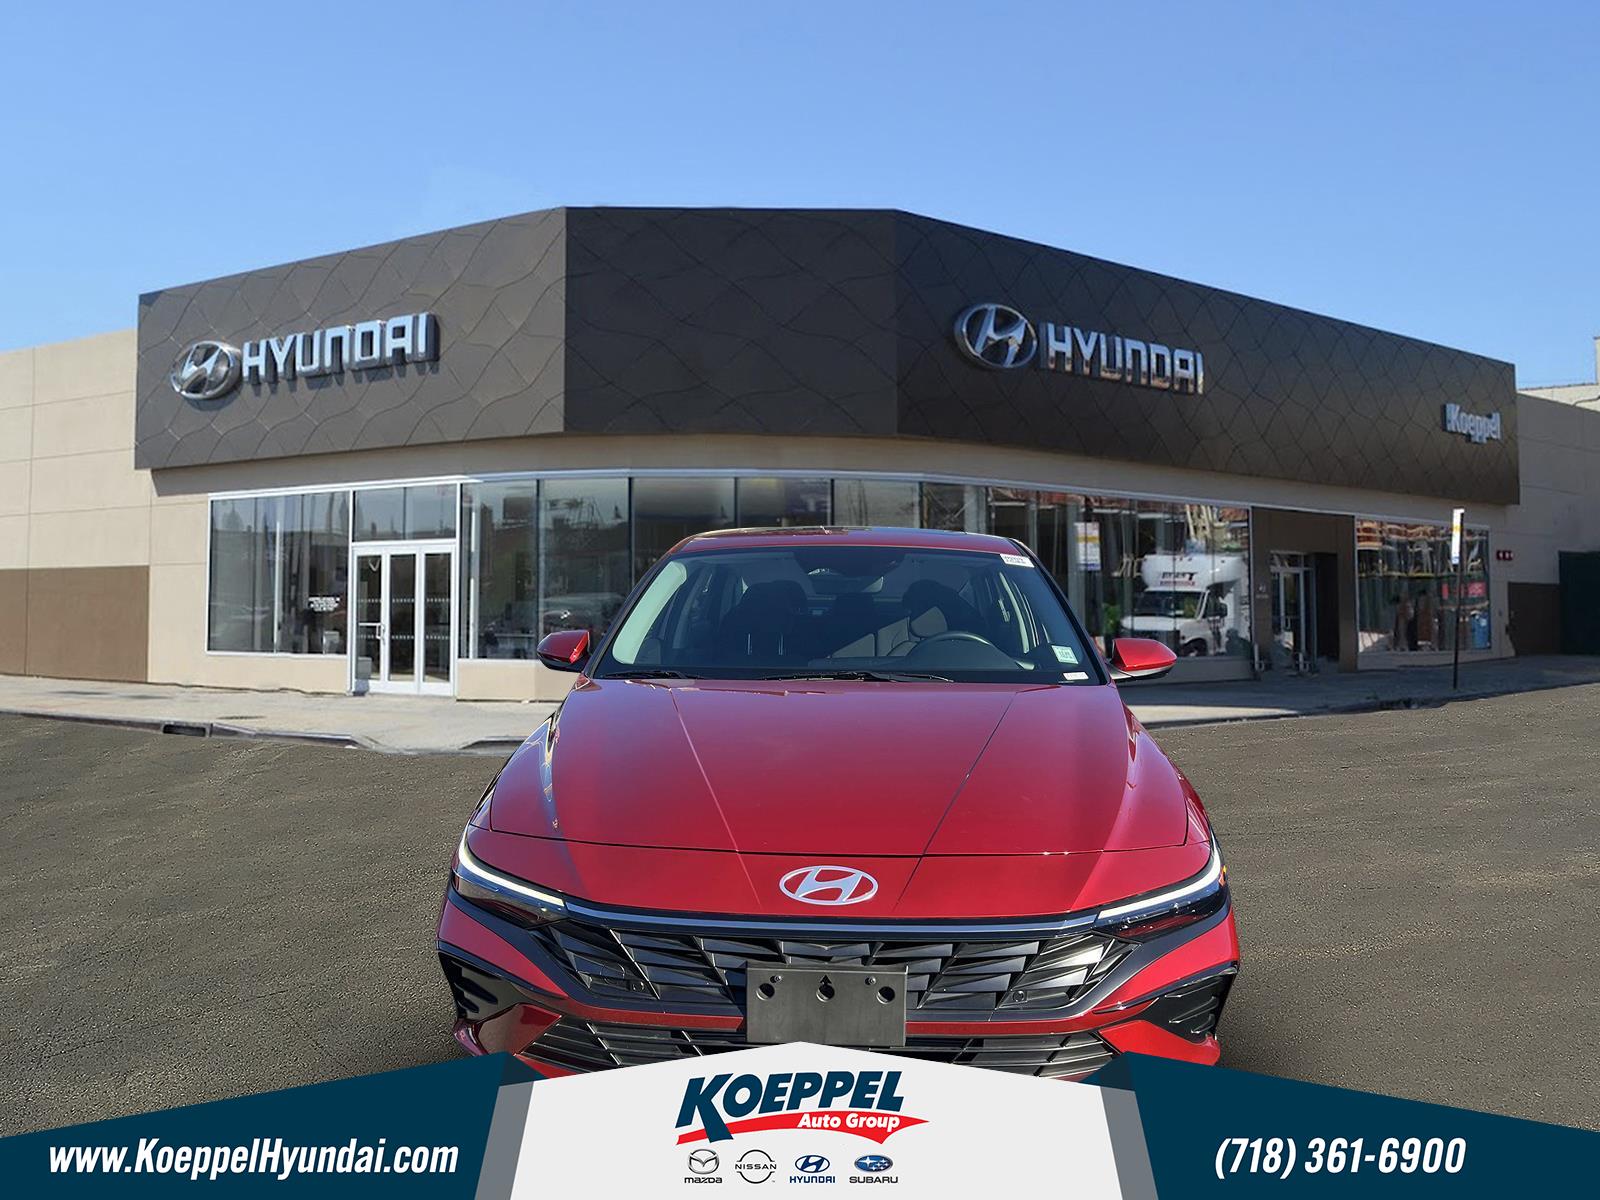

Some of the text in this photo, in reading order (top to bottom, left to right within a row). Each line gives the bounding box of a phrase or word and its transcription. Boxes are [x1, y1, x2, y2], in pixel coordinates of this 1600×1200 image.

[242, 312, 436, 382] HYUNDAI
[1044, 322, 1204, 394] HYUNDAI
[1445, 403, 1501, 443] Koeppel
